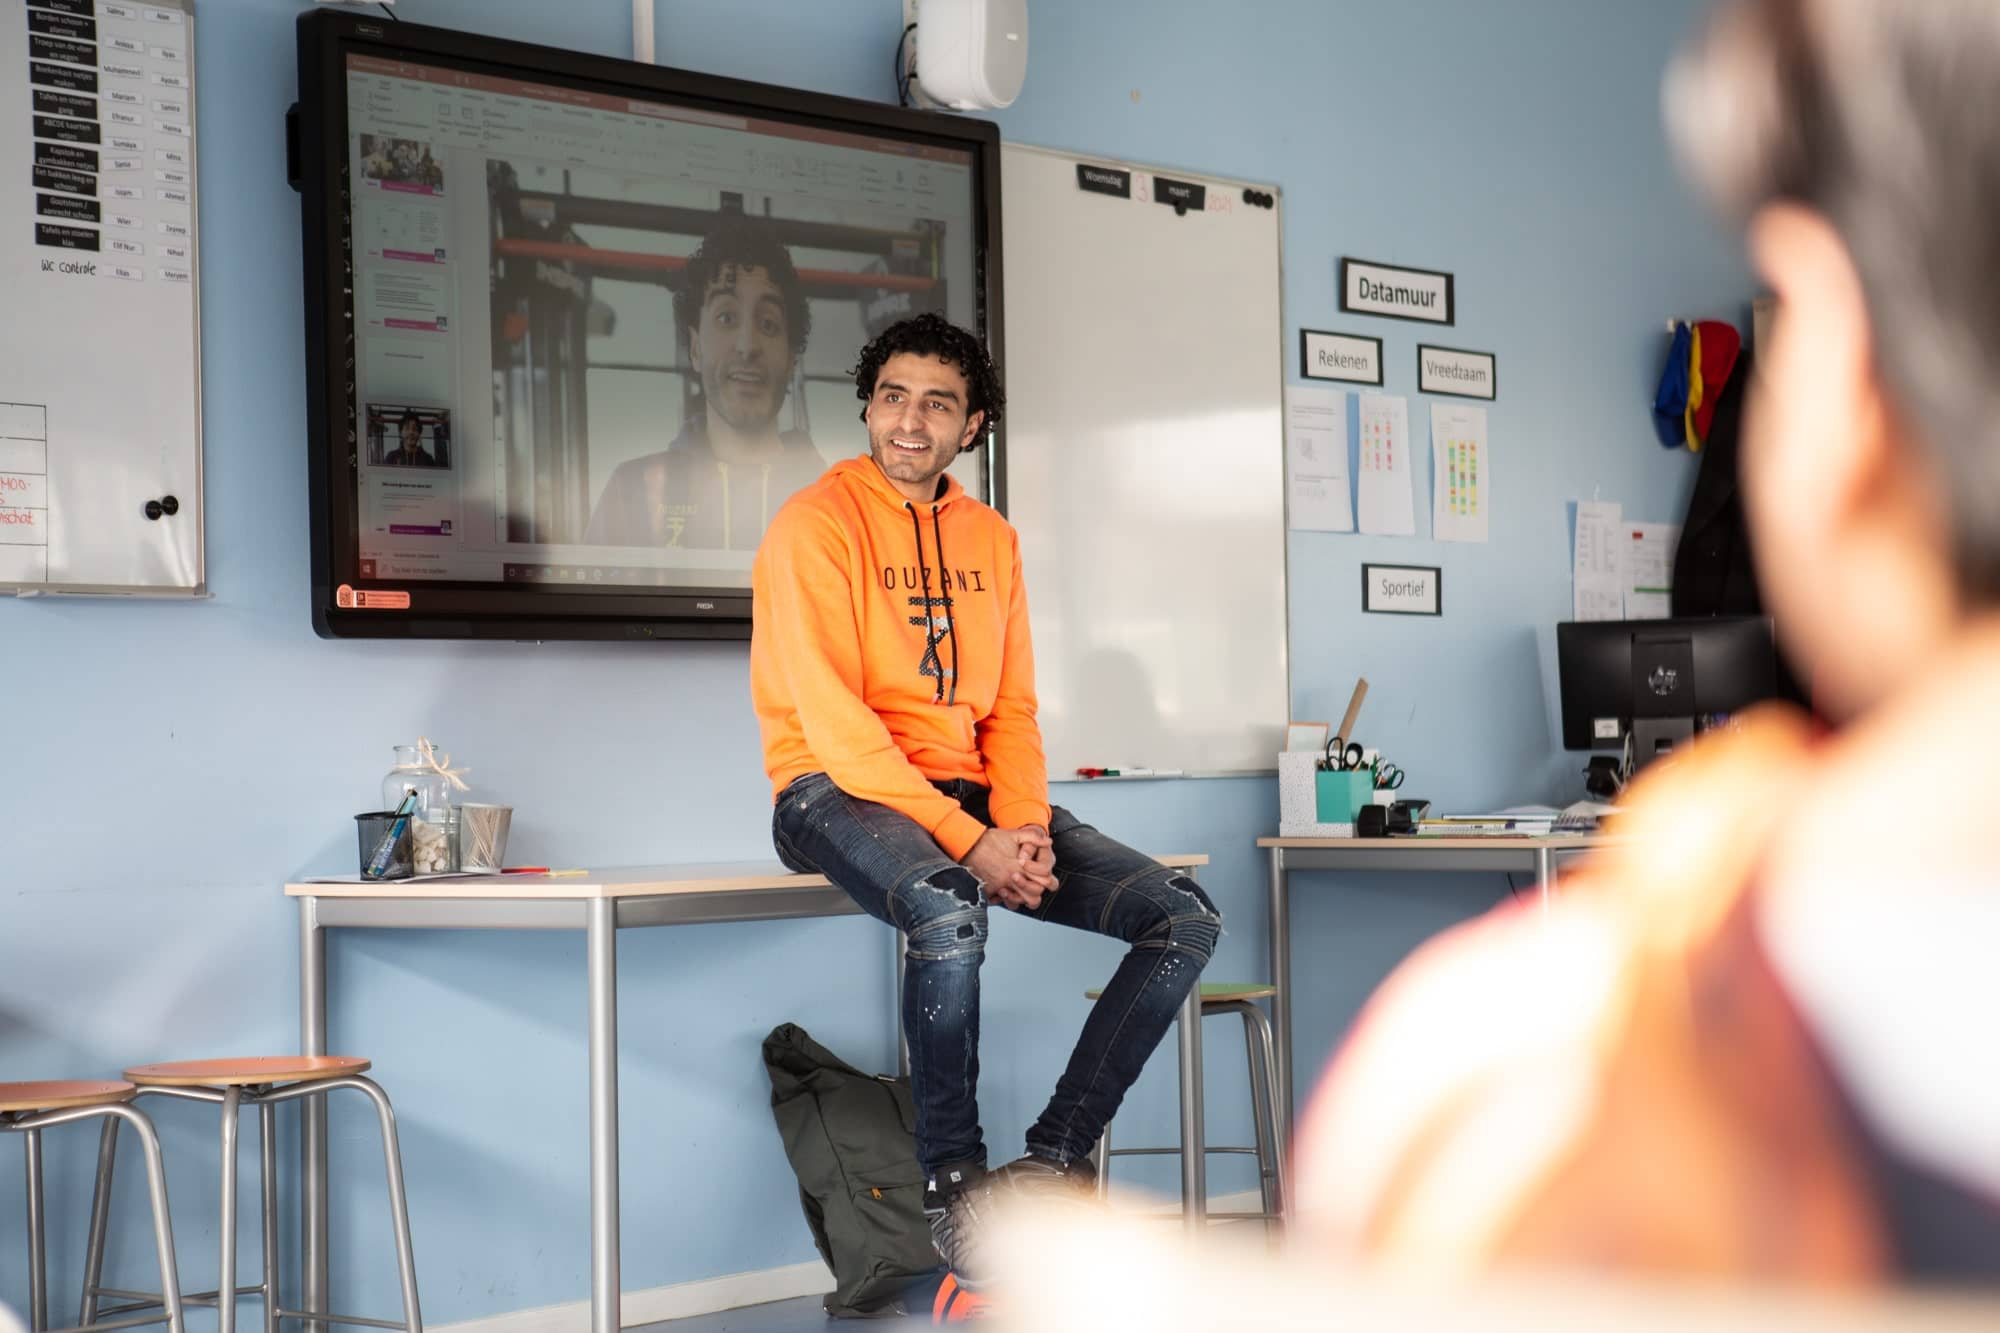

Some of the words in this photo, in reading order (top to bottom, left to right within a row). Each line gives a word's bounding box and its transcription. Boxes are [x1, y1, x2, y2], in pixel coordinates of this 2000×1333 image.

[1084, 169, 1123, 189] Woensdag
[1168, 186, 1192, 199] maart
[1358, 277, 1437, 308] Datamuur
[1318, 350, 1368, 370] Rekenen
[1426, 359, 1487, 382] Vreedzaam
[884, 566, 986, 592] OUZANI
[1381, 578, 1425, 599] Sportief
